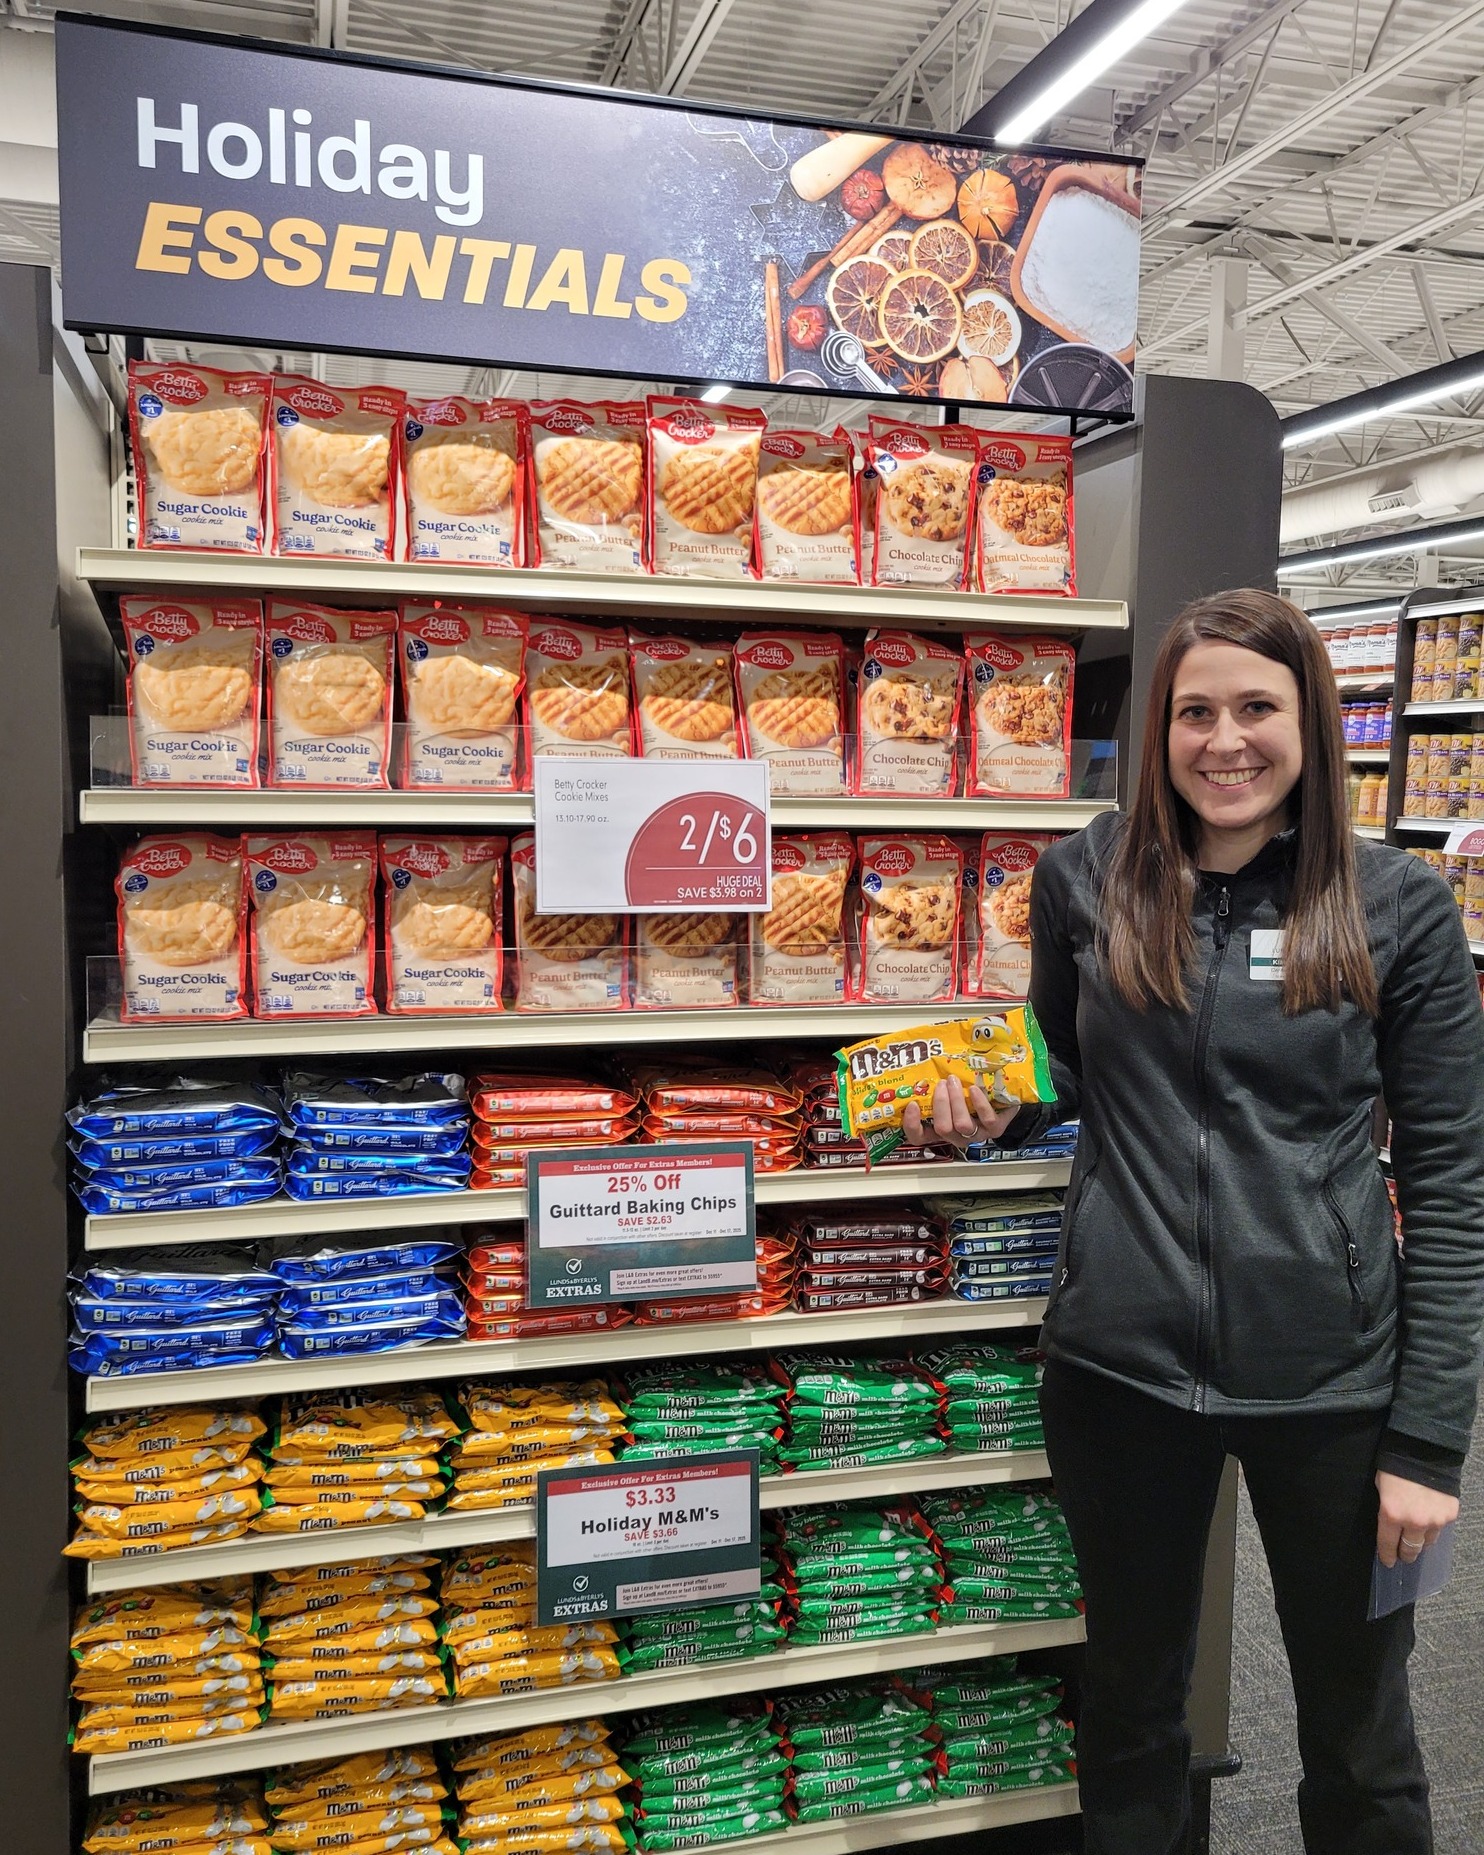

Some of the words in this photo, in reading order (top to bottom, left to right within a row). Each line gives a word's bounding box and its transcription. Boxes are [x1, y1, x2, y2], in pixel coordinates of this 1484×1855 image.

[137, 96, 484, 226] Holiday
[135, 201, 693, 324] ESSENTIALS
[157, 501, 198, 515] Sugar
[201, 504, 248, 519] Cookie
[182, 516, 208, 525] cookie
[208, 517, 224, 526] mix
[292, 511, 333, 524] Sugar
[334, 515, 376, 531] Cookie
[418, 520, 456, 534] Sugar
[457, 522, 501, 536] Cookie
[440, 533, 463, 542] cookie
[464, 534, 479, 542] mix
[670, 542, 708, 554] Peanut
[711, 545, 745, 557] Butter
[888, 550, 940, 563] Chocolate
[942, 553, 963, 568] Chip
[982, 554, 1018, 565] Oatmeal
[1020, 554, 1061, 565] Chocolate
[154, 612, 188, 626] Betty
[428, 617, 460, 632] Betty
[145, 621, 196, 638] Crocker
[419, 626, 467, 642] Crocker
[754, 645, 784, 661] Betty
[880, 640, 908, 656] Betty
[750, 654, 792, 668] Crocker
[874, 650, 914, 664] Crocker
[147, 740, 188, 753] Sugar
[190, 740, 238, 752] Cookie
[284, 741, 324, 754] Sugar
[326, 742, 370, 754] Cookie
[422, 744, 460, 758] Sugar
[462, 746, 504, 758] Cookie
[172, 752, 196, 762] cookie
[197, 754, 212, 762] mix
[768, 757, 806, 768] Peanut
[808, 757, 840, 767] Butter
[872, 754, 926, 766] Chocolate
[927, 755, 949, 769] Chip
[978, 756, 1014, 767] Oatmeal
[1014, 756, 1054, 767] Chocolate
[554, 780, 574, 791] Betty
[576, 780, 607, 790] Crocker
[555, 792, 584, 802] Cookie
[585, 792, 608, 802] Mixes
[556, 815, 596, 823] 13.10-17.90
[680, 811, 757, 864] 2/$6
[149, 850, 180, 863] Betty
[880, 850, 906, 864] Betty
[874, 858, 912, 871] Crocker
[716, 876, 742, 888] HUGE
[742, 876, 762, 888] DEAL
[678, 888, 707, 898] SAVE
[709, 888, 737, 899] $3.98
[740, 890, 754, 898] on
[756, 888, 762, 898] 2
[652, 968, 690, 978] Peanut
[692, 966, 726, 977] Butter
[765, 966, 802, 977] Peanut
[805, 965, 838, 975] Butter
[876, 962, 928, 974] Chocolate
[930, 963, 950, 977] Chip
[984, 960, 1018, 970] Oatmeal
[138, 974, 178, 988] Sugar
[181, 974, 227, 986] Cookie
[271, 972, 310, 985] Sugar
[313, 972, 356, 982] Cookie
[404, 968, 442, 982] Sugar
[444, 968, 486, 980] Cookie
[530, 972, 570, 983] Peanut
[572, 971, 610, 982] Butter
[162, 986, 186, 995] cookie
[188, 987, 203, 995] mix
[878, 1075, 904, 1086] blend
[145, 1119, 182, 1132] Guittard
[144, 1145, 182, 1159] Guittard
[574, 1164, 611, 1172] Exclusive
[612, 1162, 632, 1170] Offer
[676, 1158, 712, 1168] Members!
[155, 1171, 192, 1184] Guittard
[608, 1175, 647, 1193] 25%
[654, 1174, 681, 1190] Off
[550, 1200, 620, 1218] Guittard
[627, 1198, 684, 1216] Baking
[690, 1196, 737, 1212] Chips
[618, 1217, 644, 1227] SAVE
[646, 1215, 672, 1226] $2.63
[842, 1228, 870, 1240] Guittard
[838, 1252, 868, 1264] Guittard
[550, 1276, 598, 1286] LUNDS&BYERLYS
[837, 1274, 867, 1286] Guittard
[546, 1284, 602, 1298] EXTRAS
[835, 1294, 864, 1306] Guittard
[582, 1479, 618, 1490] Exclusive
[620, 1476, 640, 1485] Offer
[656, 1474, 682, 1482] Extras
[683, 1468, 718, 1478] Members!
[626, 1486, 676, 1508] $3.33
[582, 1516, 652, 1534] Holiday
[658, 1507, 719, 1526] M&M's
[624, 1530, 650, 1542] SAVE
[652, 1528, 678, 1539] $3.66
[558, 1592, 604, 1604] LUNDS&BYERLYS
[554, 1600, 608, 1617] EXTRAS
